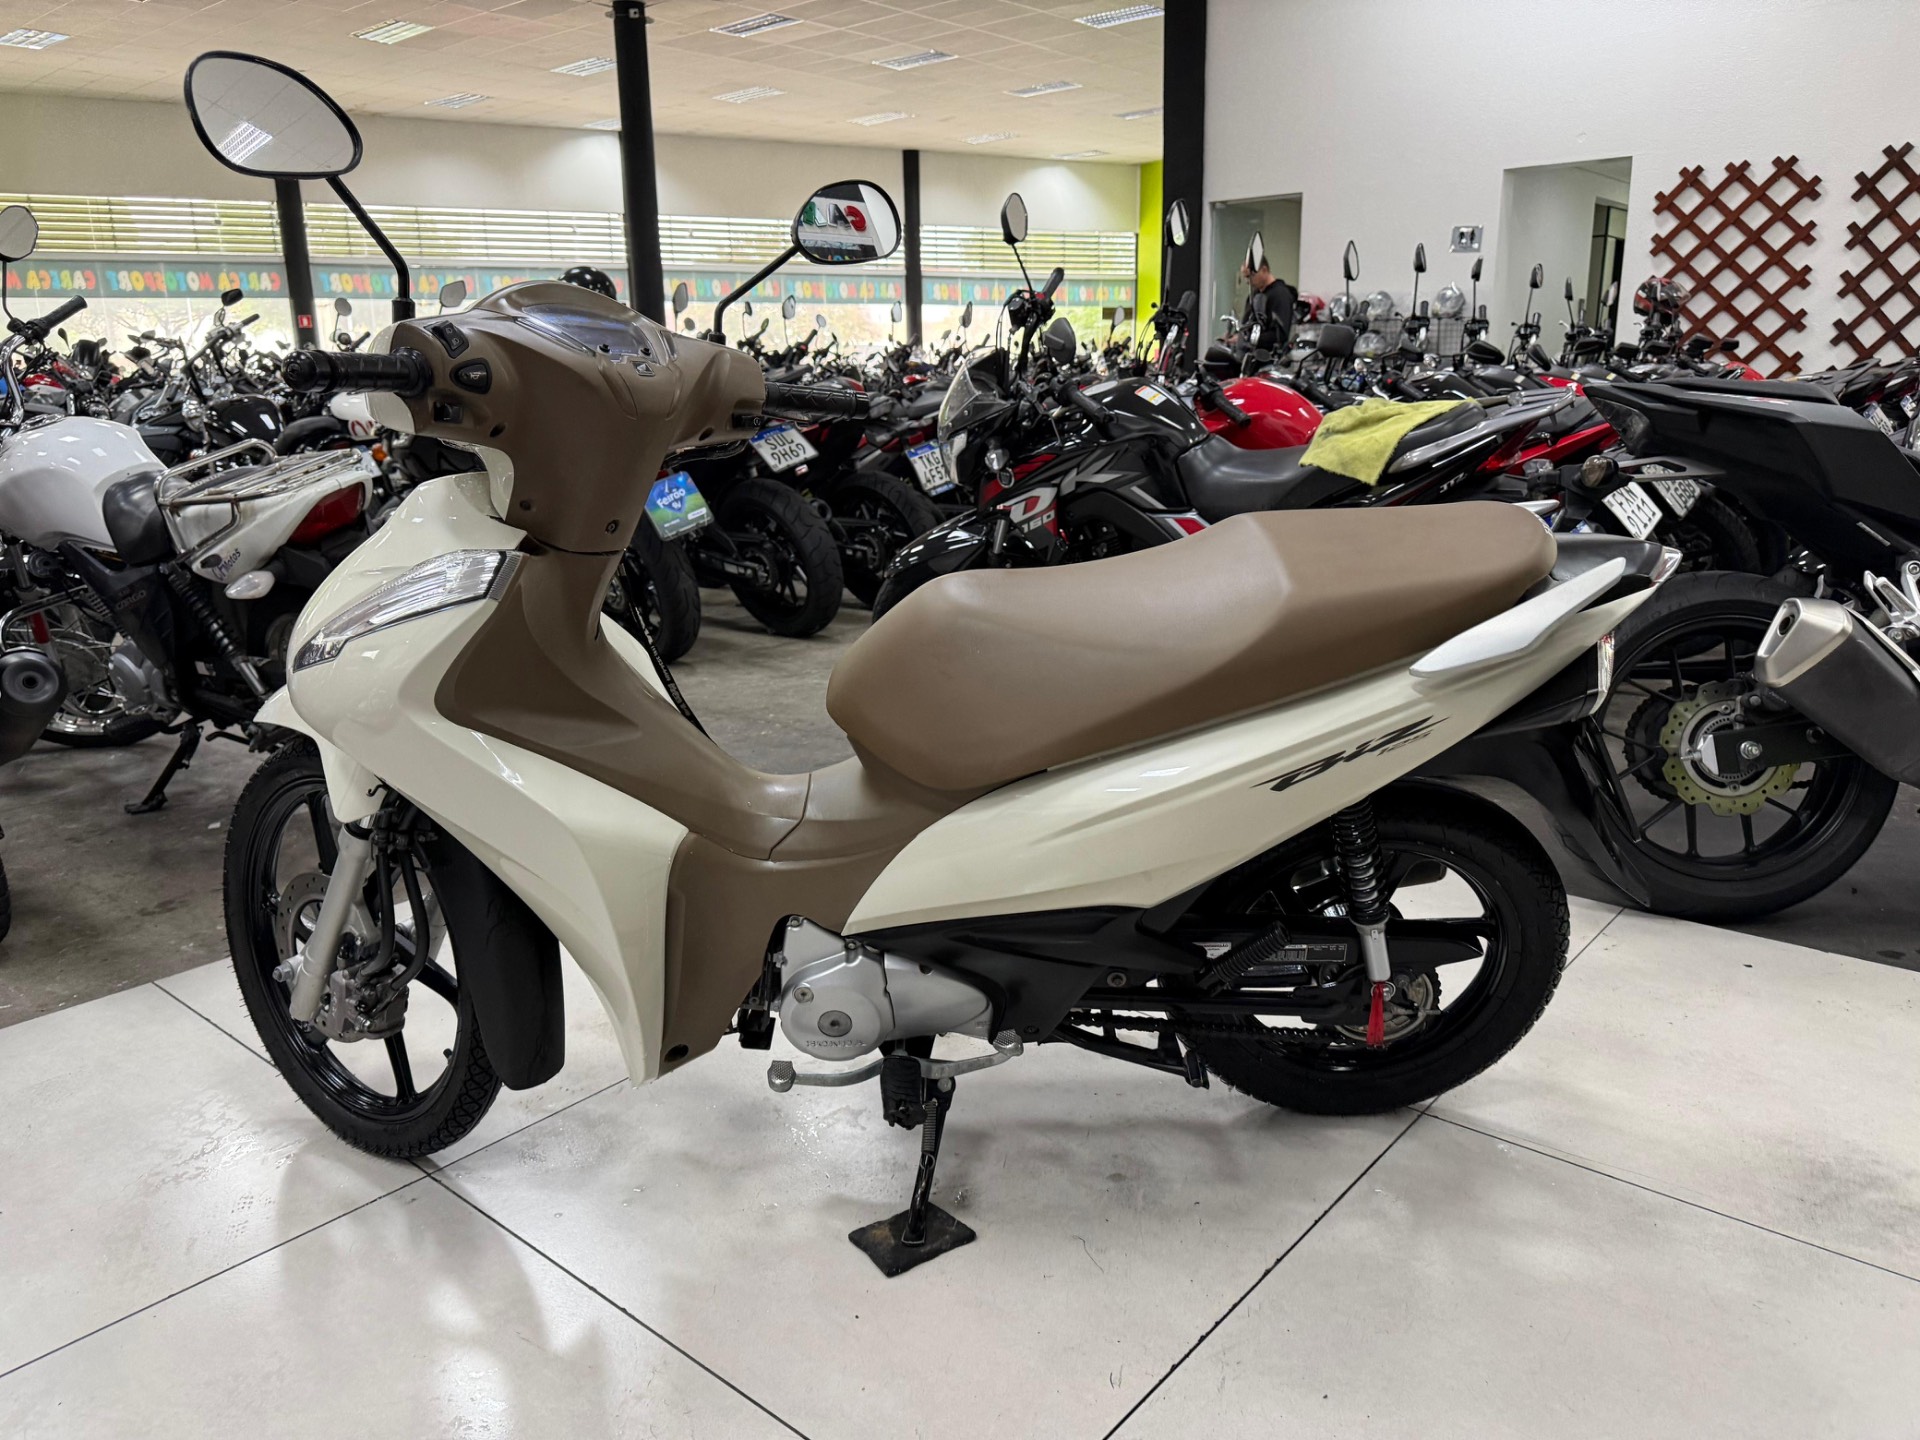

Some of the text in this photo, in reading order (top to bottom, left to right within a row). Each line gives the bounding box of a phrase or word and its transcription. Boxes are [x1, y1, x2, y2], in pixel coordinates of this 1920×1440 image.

[765, 433, 794, 450] SUL
[918, 451, 940, 469] TKG
[1022, 510, 1055, 533] 160
[806, 1040, 868, 1048] HONDA
